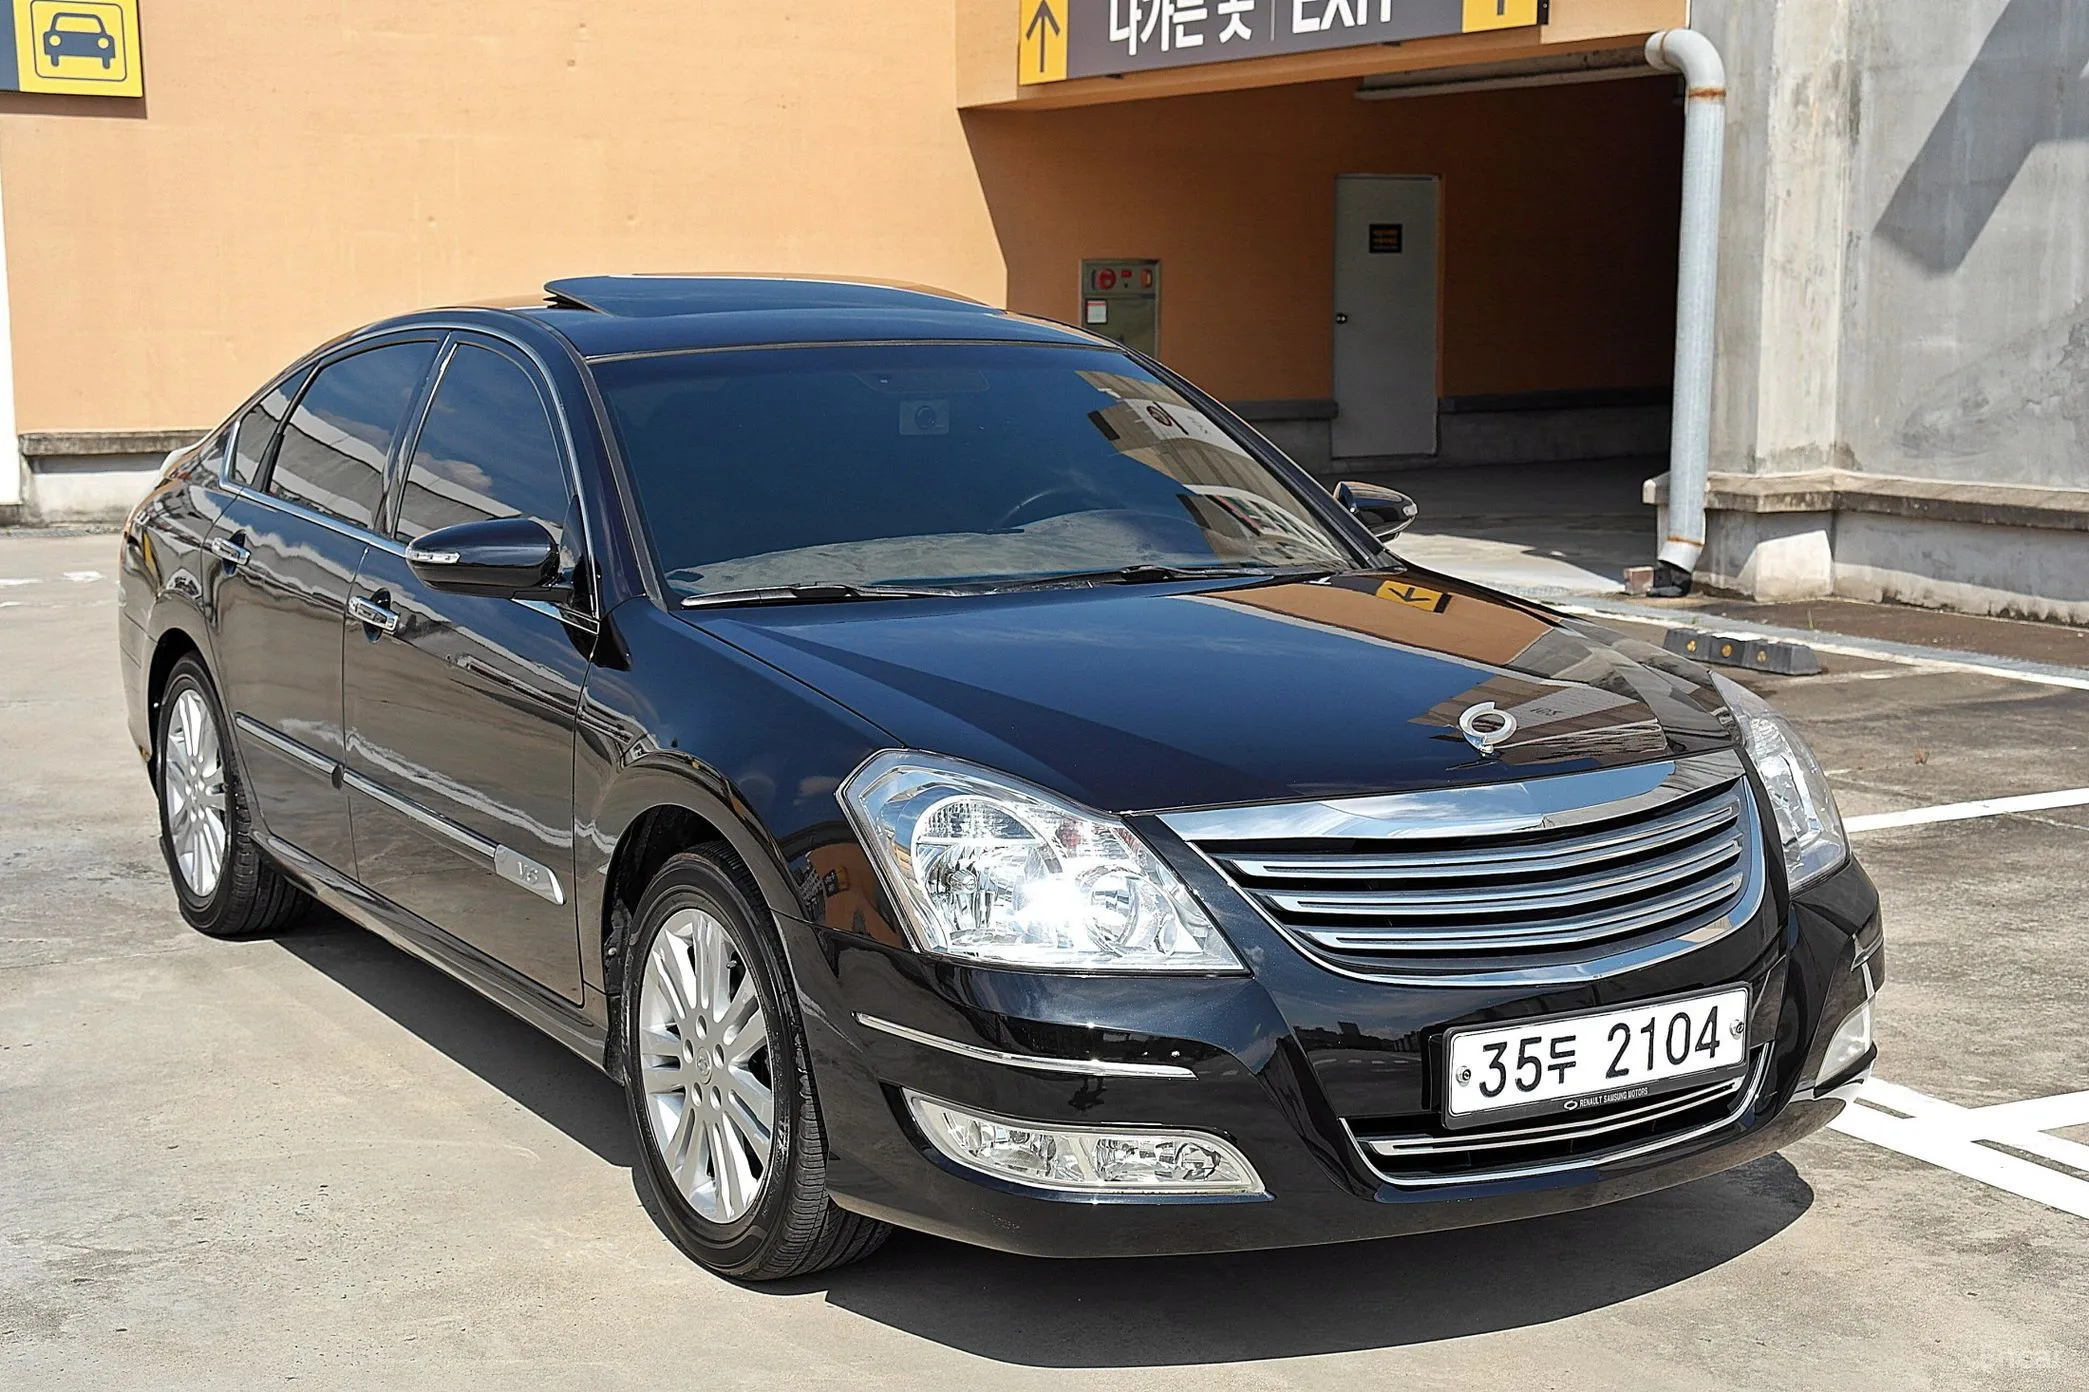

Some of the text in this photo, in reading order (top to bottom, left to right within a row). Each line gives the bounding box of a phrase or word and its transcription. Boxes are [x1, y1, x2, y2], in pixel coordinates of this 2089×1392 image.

[1478, 1005, 1721, 1098] 35두 2104
[1579, 1086, 1649, 1108] RENAULT SAMSUNG MOTORS
